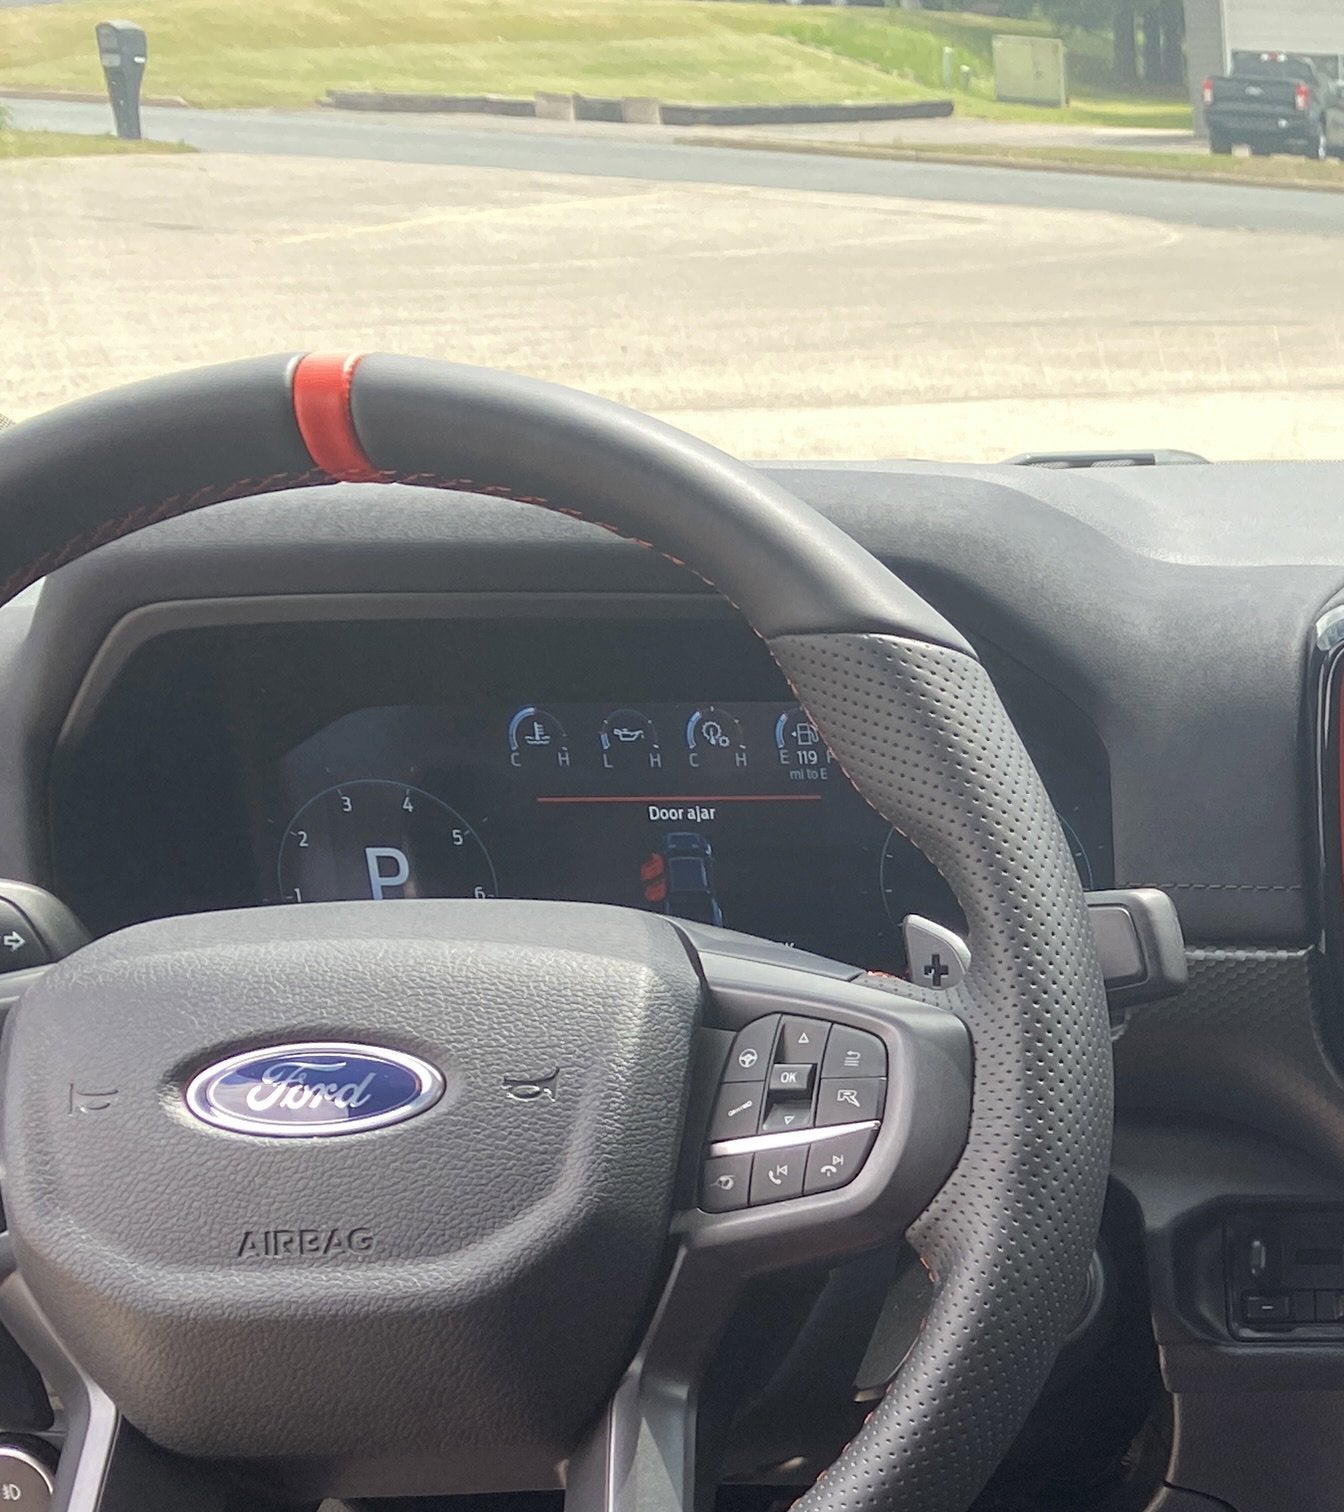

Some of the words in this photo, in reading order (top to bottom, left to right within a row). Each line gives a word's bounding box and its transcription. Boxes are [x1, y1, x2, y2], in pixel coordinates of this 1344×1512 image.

[511, 753, 521, 766] C
[559, 752, 570, 766] H
[604, 754, 614, 768] L
[650, 753, 662, 767] H
[690, 753, 699, 766] C
[736, 752, 748, 766] H
[781, 750, 789, 764] E
[797, 750, 817, 764] 119
[790, 768, 803, 779] mi
[807, 768, 818, 779] to
[820, 767, 828, 779] E
[341, 796, 352, 812] 3
[402, 796, 413, 812] 4
[649, 806, 683, 820] Door
[688, 806, 716, 824] ajar
[298, 831, 309, 847] 2
[452, 829, 463, 845] 5
[365, 847, 409, 900] P
[781, 1072, 797, 1083] OK
[246, 1061, 371, 1113] Ford
[236, 1226, 376, 1258] AIRBAG
